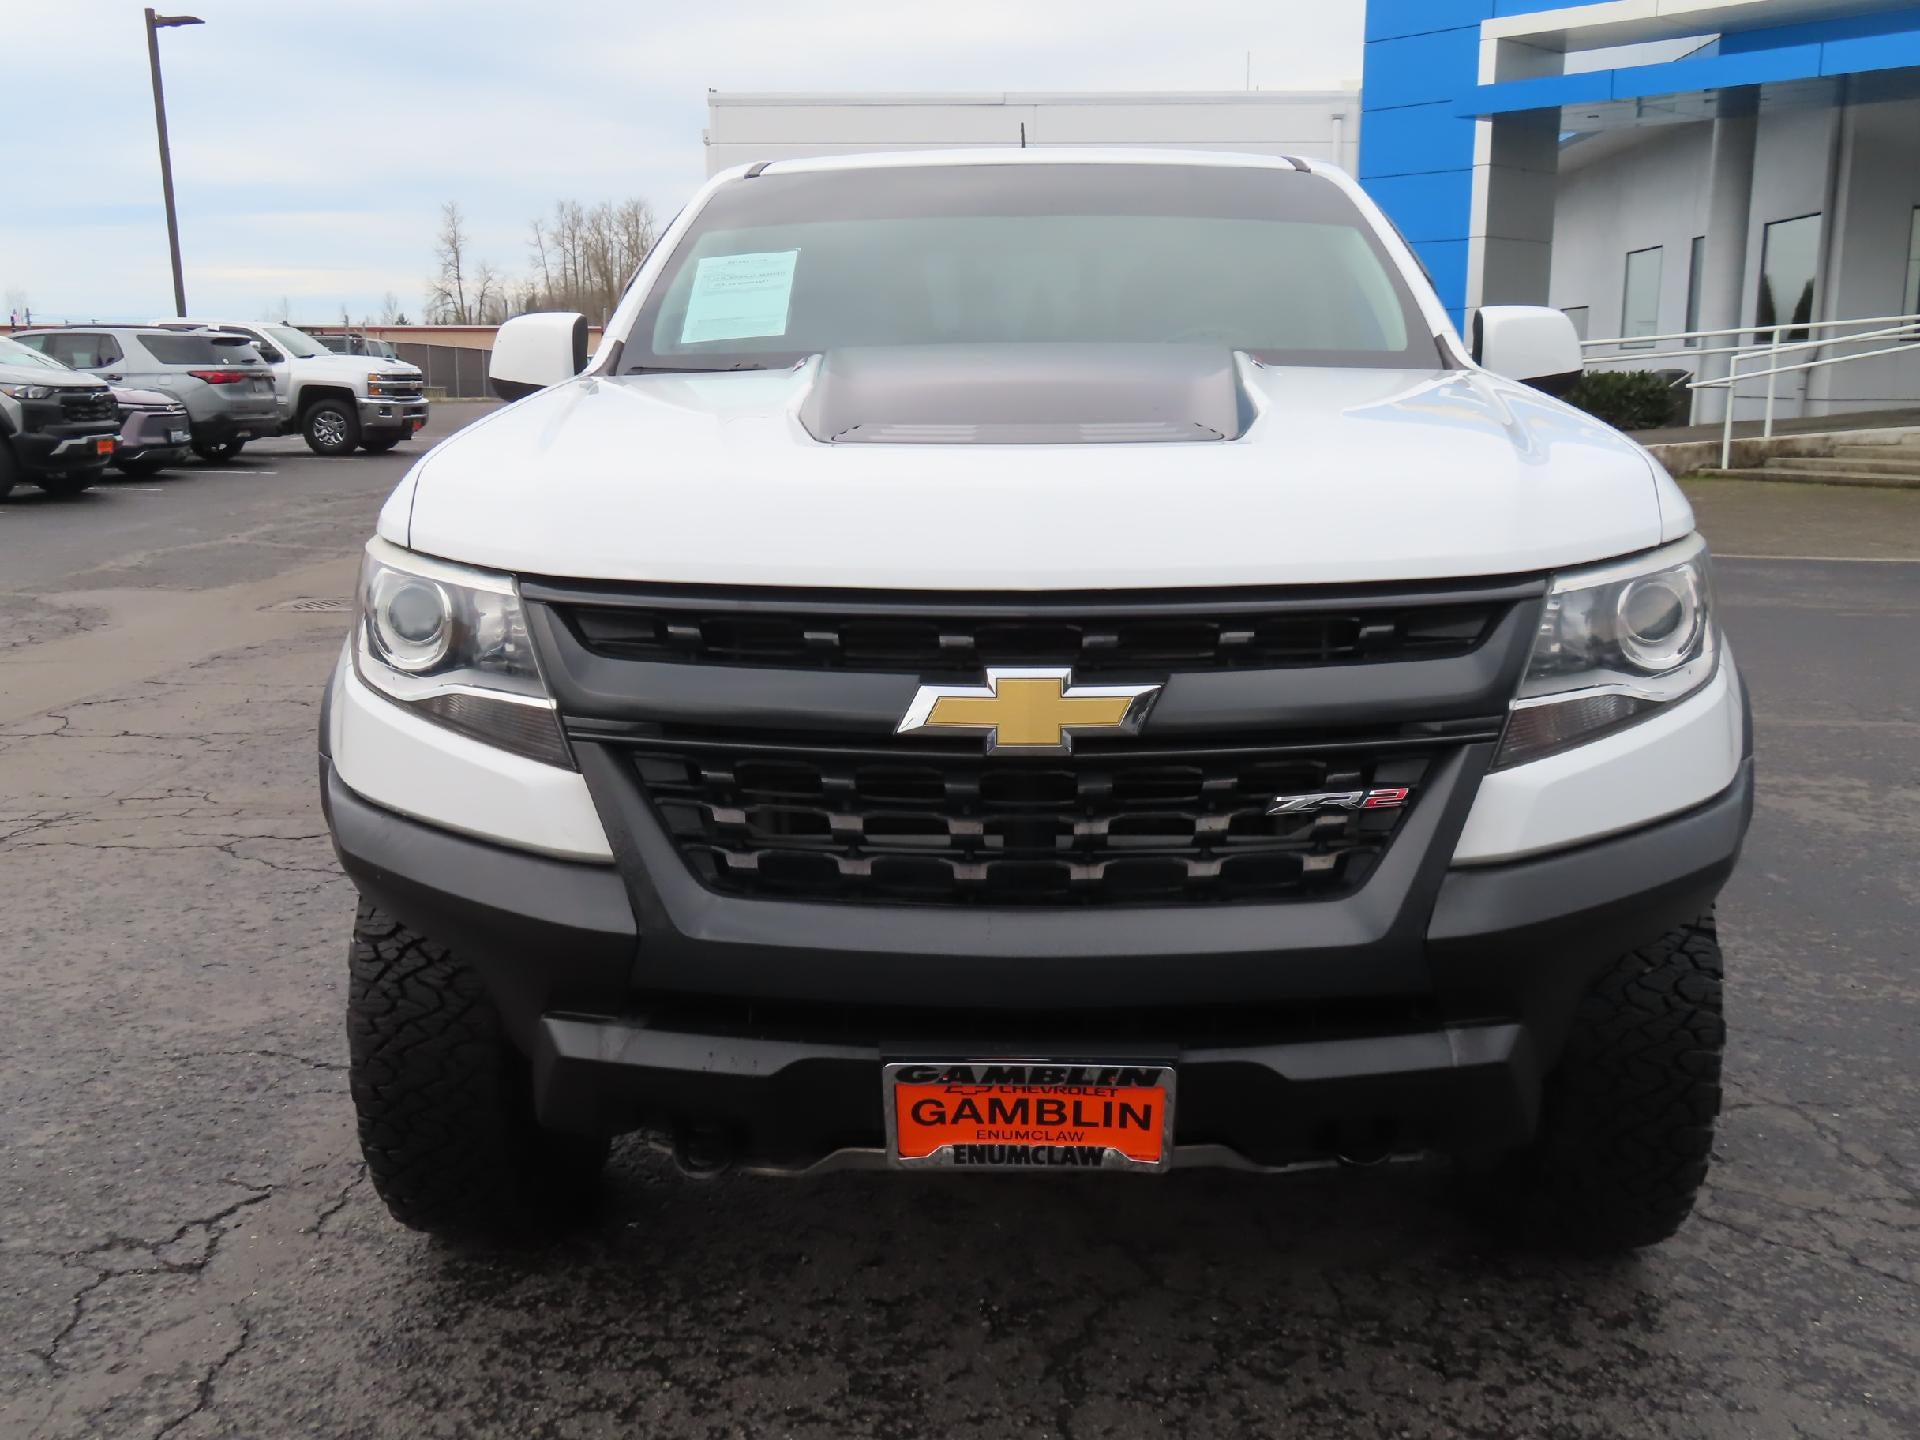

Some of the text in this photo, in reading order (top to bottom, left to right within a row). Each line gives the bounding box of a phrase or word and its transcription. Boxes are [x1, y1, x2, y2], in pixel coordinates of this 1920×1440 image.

[1265, 787, 1409, 815] ZR2
[895, 1066, 1163, 1087] GAMBLIN
[999, 1086, 1118, 1097] CHEVROLET
[911, 1098, 1152, 1131] GAMBLIN
[976, 1130, 1084, 1142] ENUMCLAW
[953, 1145, 1106, 1165] ENUMCLAW
